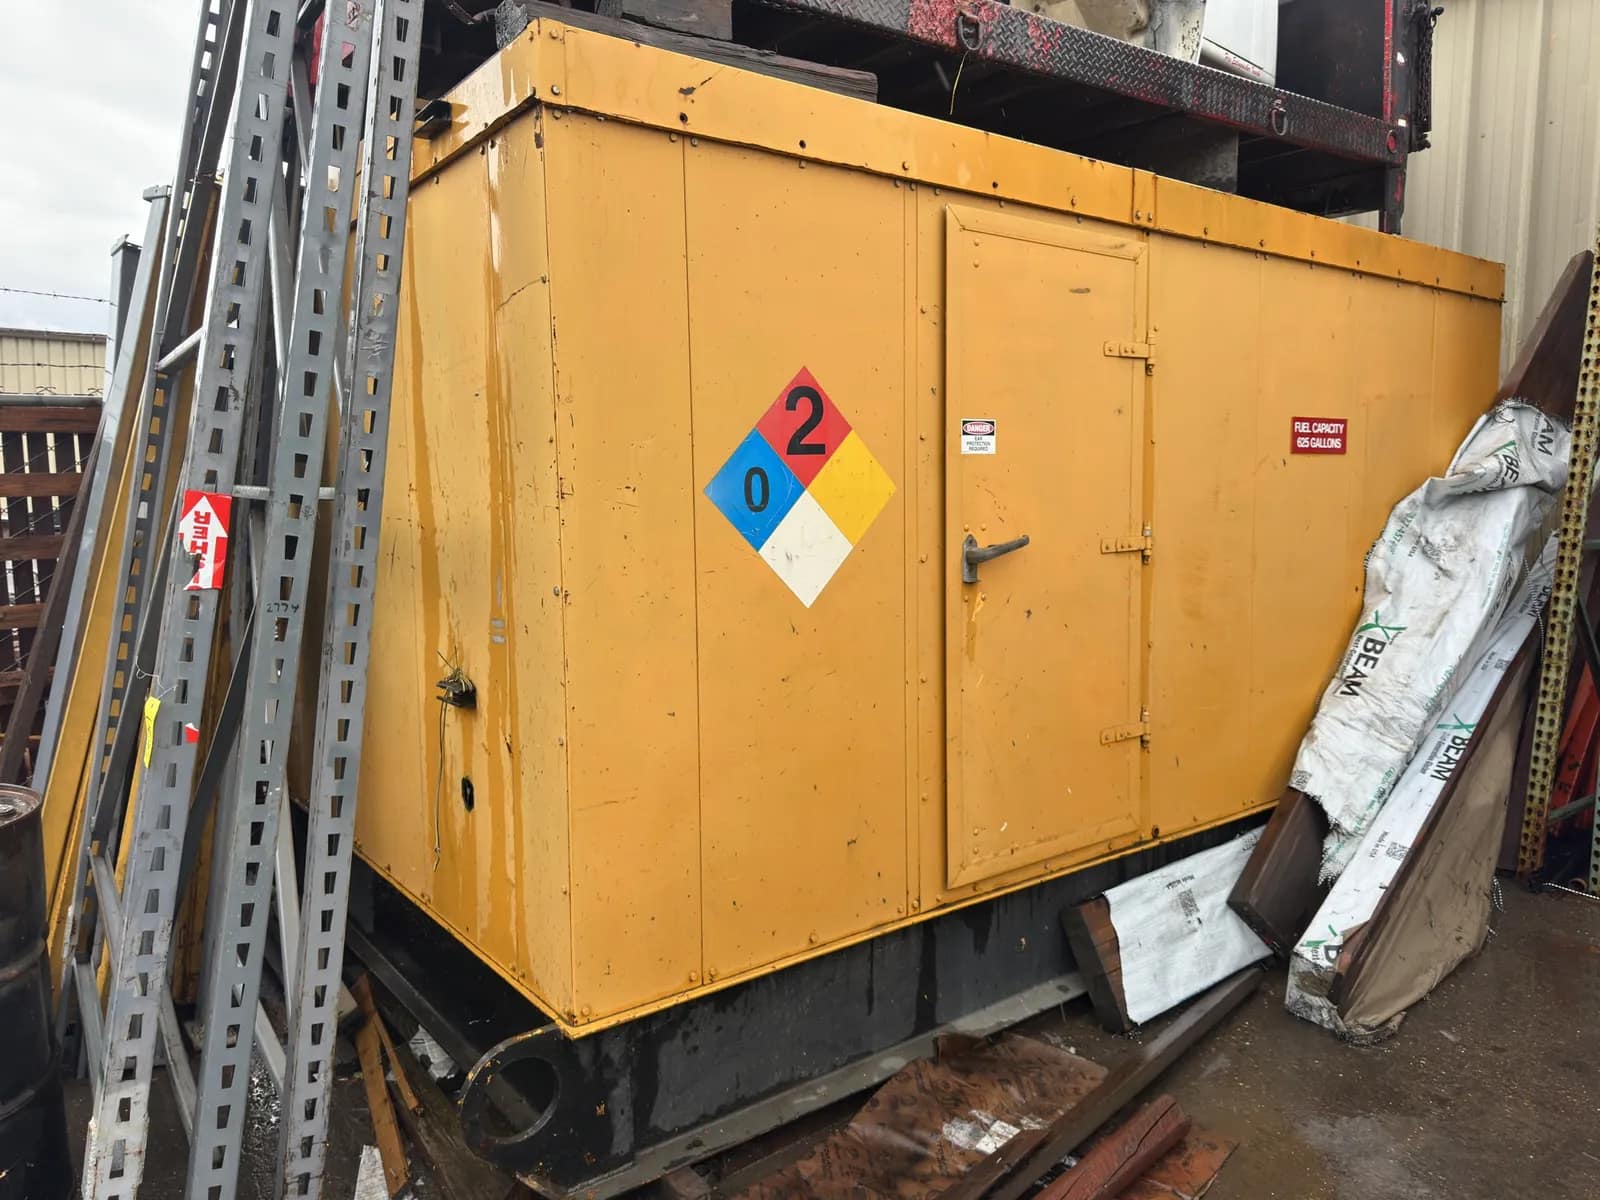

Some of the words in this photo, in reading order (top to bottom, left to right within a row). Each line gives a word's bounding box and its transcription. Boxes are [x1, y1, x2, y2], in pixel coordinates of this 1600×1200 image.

[786, 386, 826, 456] 2
[966, 424, 990, 432] DANGER
[1294, 421, 1312, 433] FUEL
[1312, 422, 1344, 434] CAPACITY
[1296, 437, 1310, 448] 625
[1310, 438, 1342, 449] GALLONS
[744, 467, 770, 512] 0
[1340, 637, 1387, 697] BEAM
